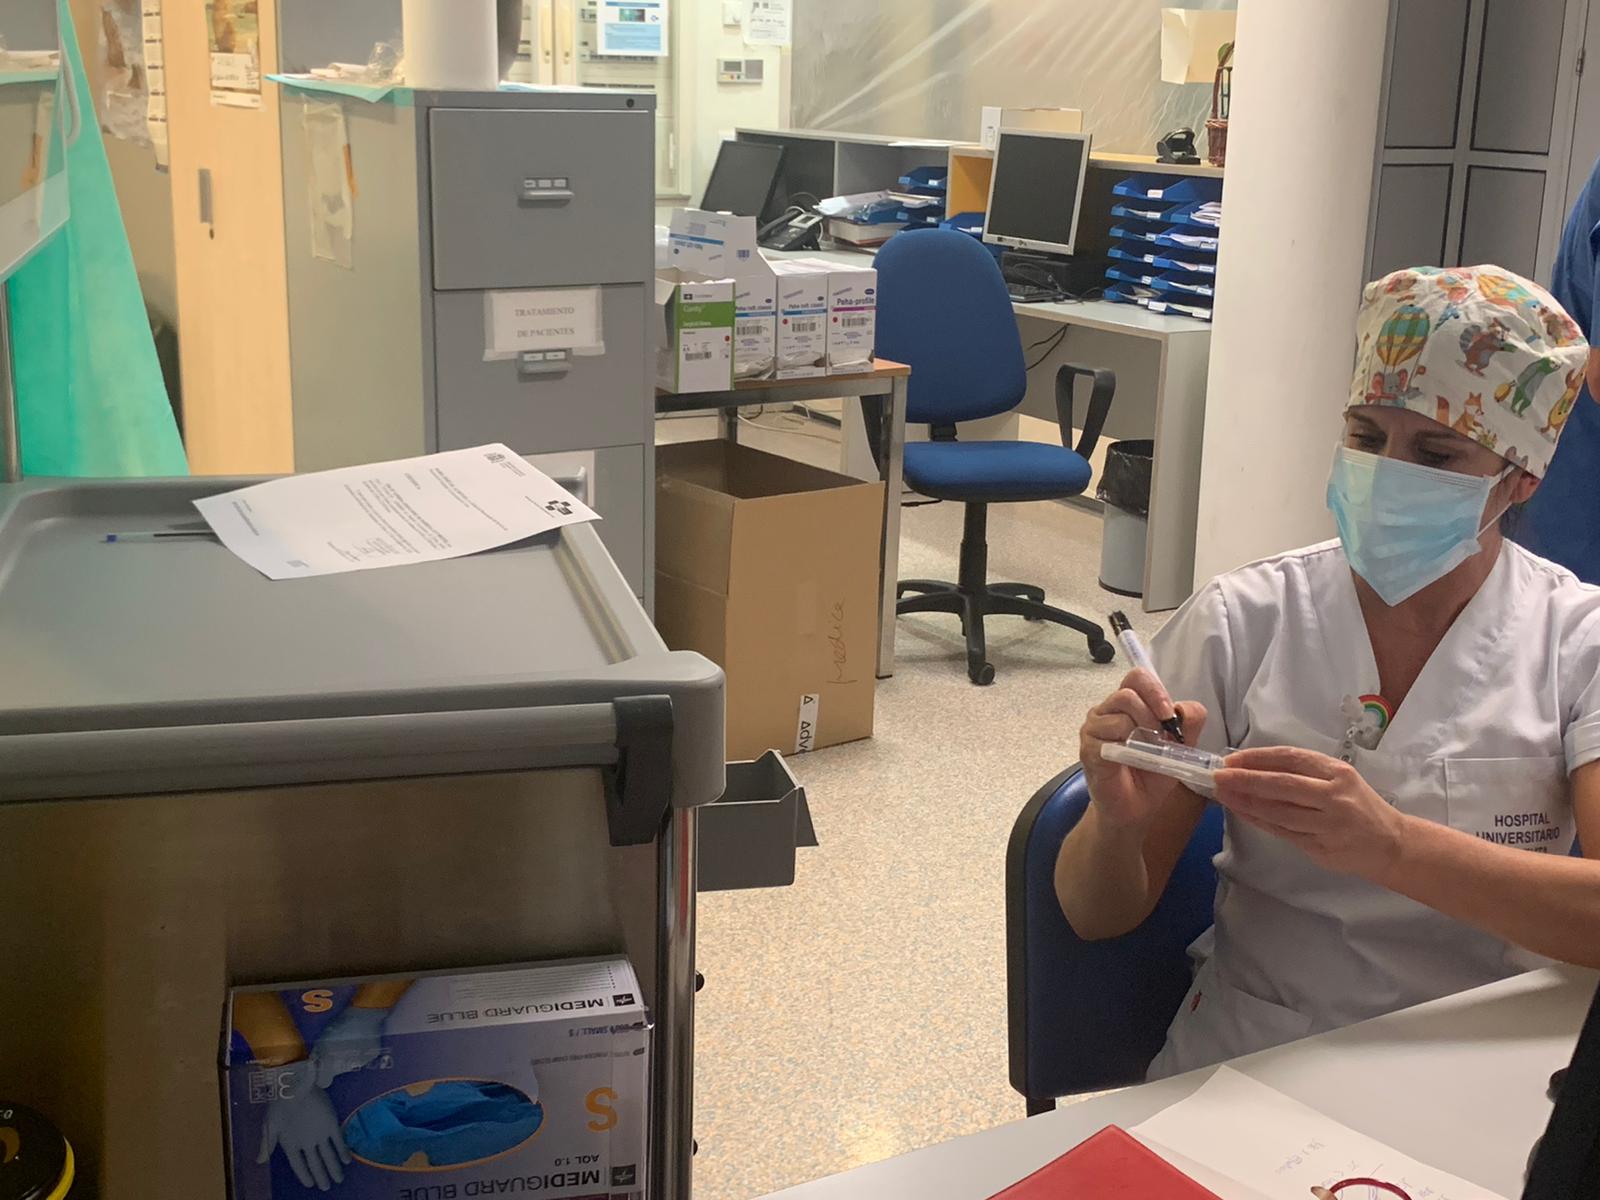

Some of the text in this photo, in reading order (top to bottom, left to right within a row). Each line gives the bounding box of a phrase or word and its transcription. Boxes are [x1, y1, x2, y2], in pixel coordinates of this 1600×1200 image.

[514, 306, 576, 317] TRATAMIENTO
[516, 327, 576, 339] DE PACIENTES
[1494, 812, 1551, 828] HOSPITAL
[301, 988, 334, 1013] S
[427, 998, 605, 1024] MEDIGUARD BLUE
[584, 1086, 619, 1133] S
[554, 1154, 600, 1167] AQL 1.0
[399, 1169, 600, 1200] MEDIGUARD BLUE
